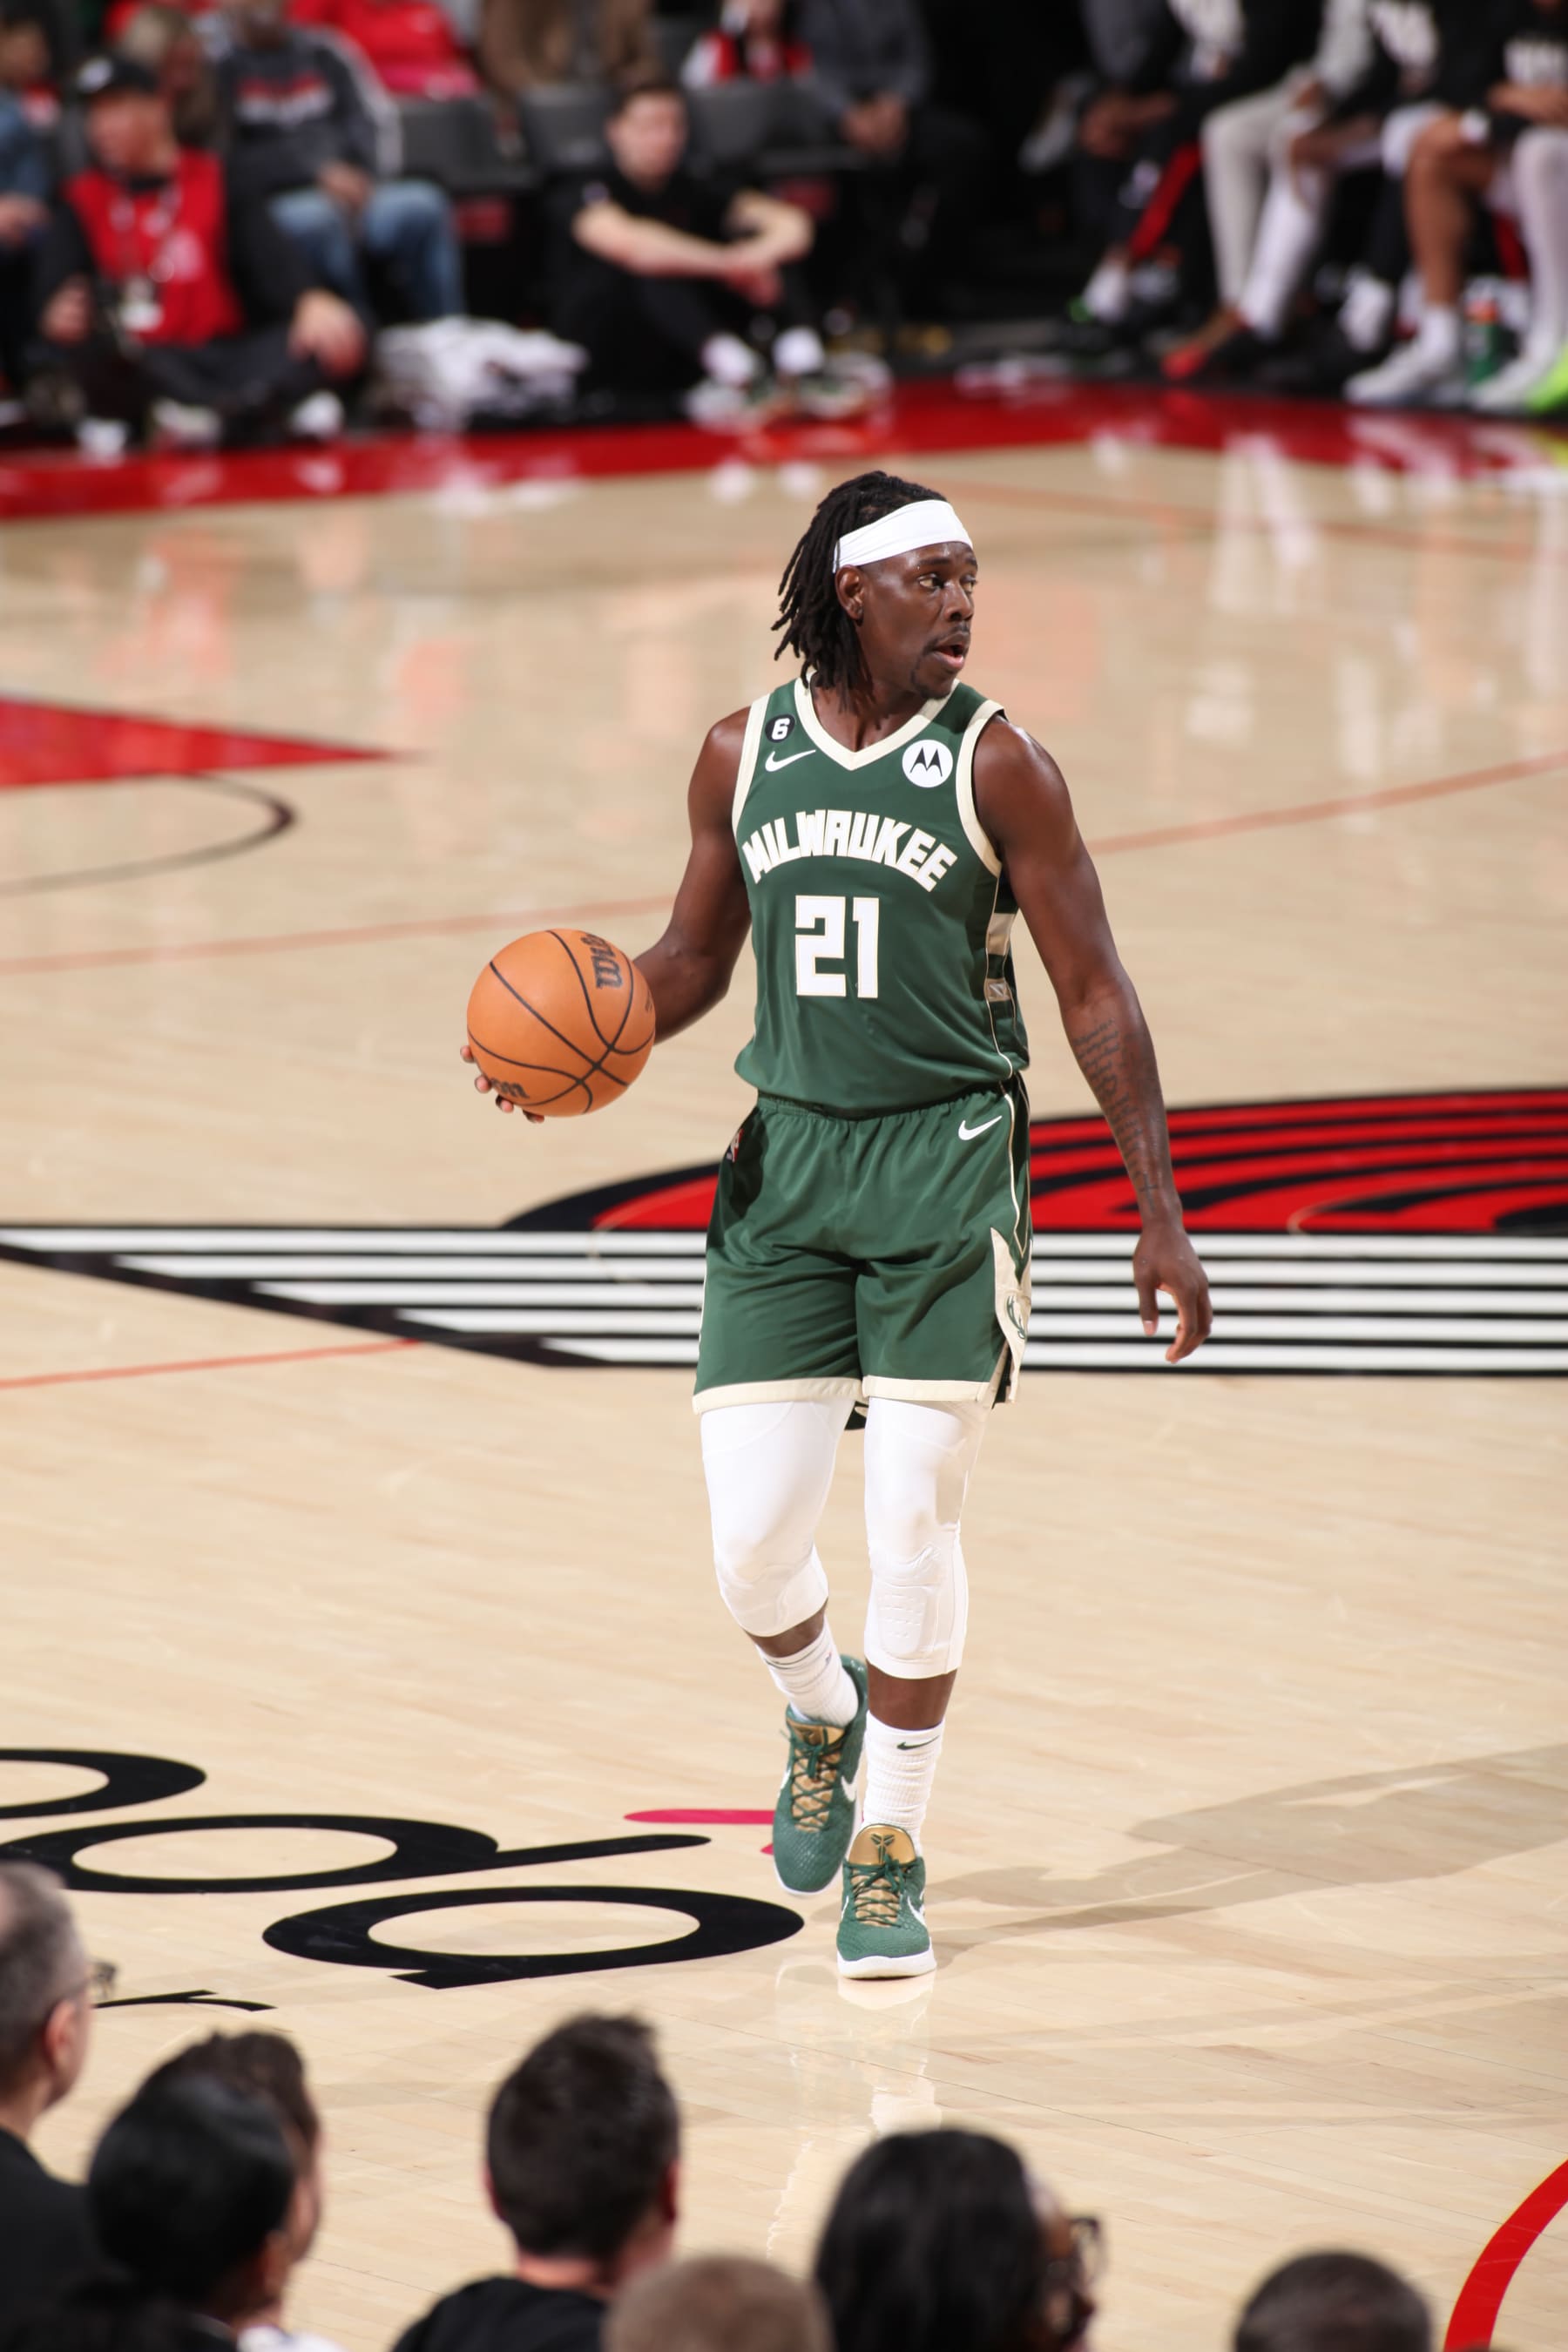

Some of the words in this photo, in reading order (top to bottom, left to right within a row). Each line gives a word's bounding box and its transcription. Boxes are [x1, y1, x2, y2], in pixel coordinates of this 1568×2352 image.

[771, 717, 791, 741] 6
[742, 809, 958, 893] MILWAUKEE
[794, 895, 880, 999] 21
